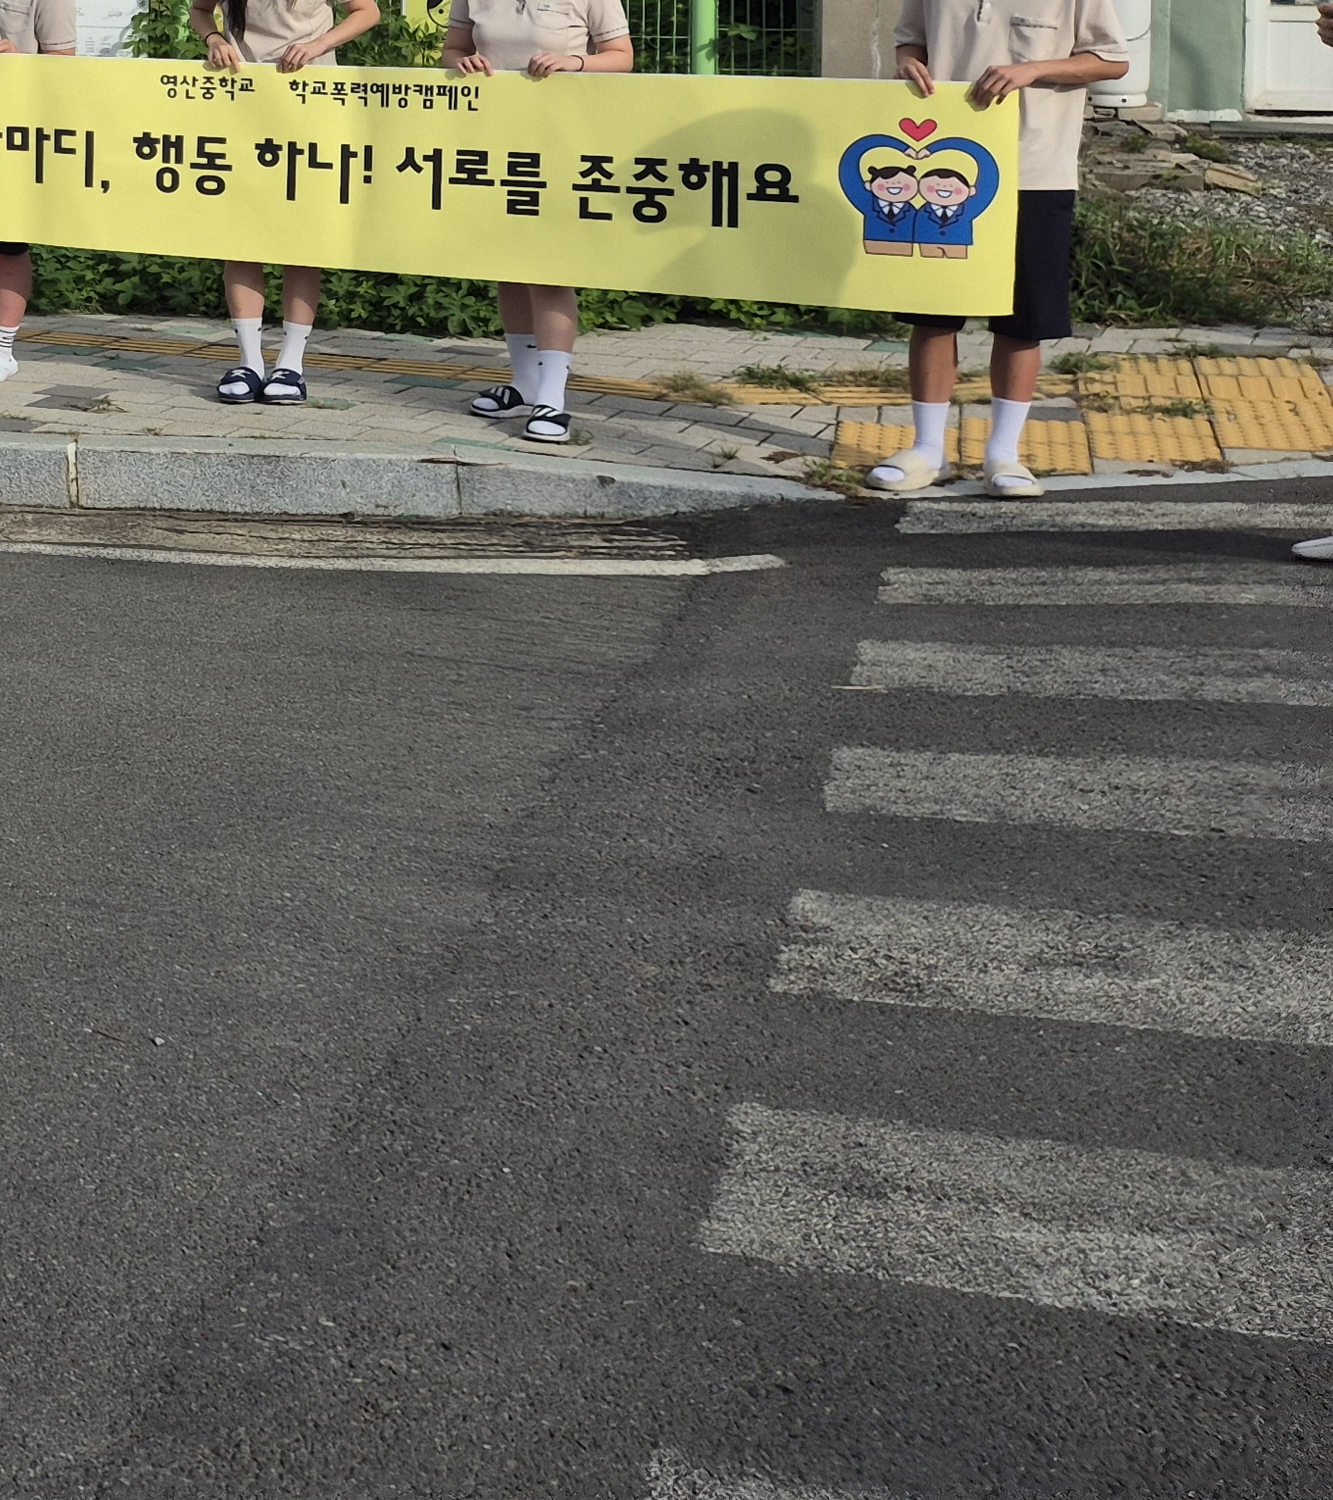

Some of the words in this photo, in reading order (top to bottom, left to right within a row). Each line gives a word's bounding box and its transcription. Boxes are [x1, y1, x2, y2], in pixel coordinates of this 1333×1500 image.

[160, 74, 256, 102] 영산중학교
[288, 78, 480, 112] 학교폭력예방캠페인
[133, 131, 233, 196] 행동
[254, 137, 373, 205] 하나!
[395, 146, 548, 217] 서로를
[572, 153, 799, 228] 존중해요
